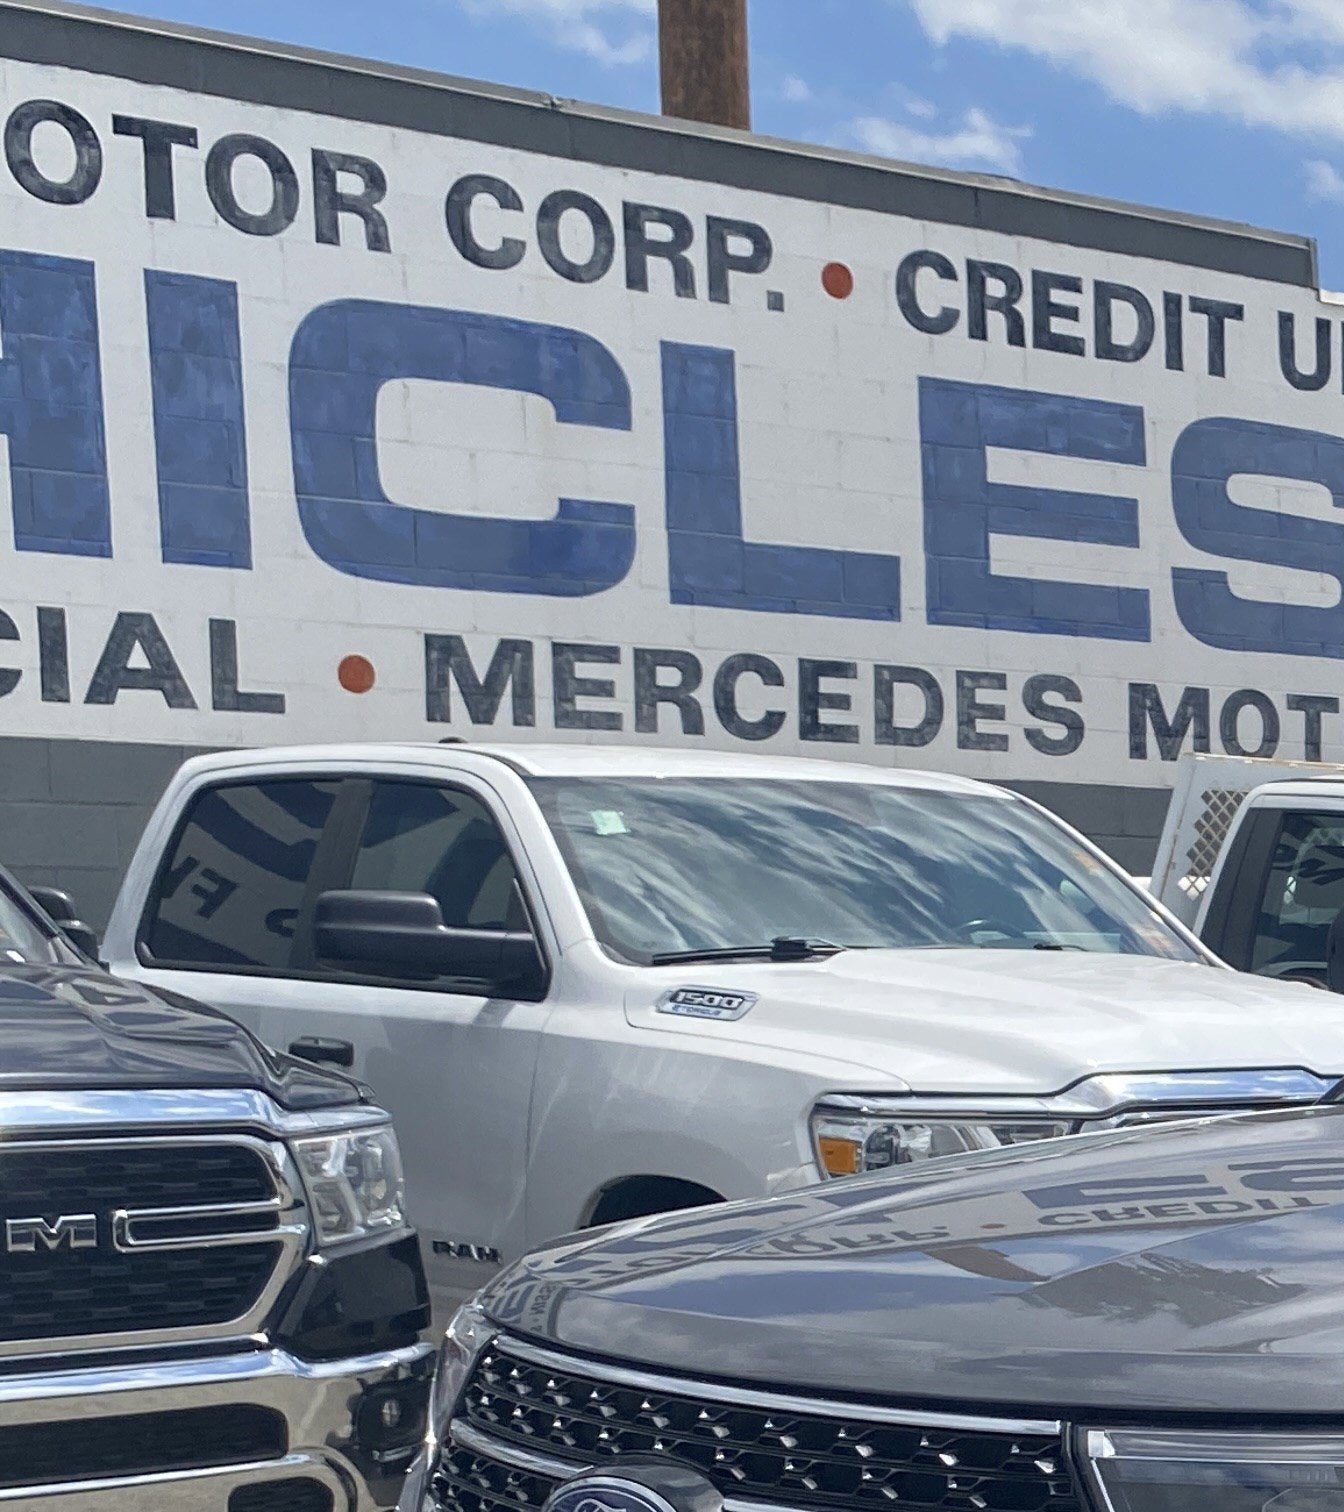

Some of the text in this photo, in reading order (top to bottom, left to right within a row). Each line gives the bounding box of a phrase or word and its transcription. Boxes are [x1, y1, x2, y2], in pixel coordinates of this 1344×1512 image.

[445, 173, 785, 313] CORP.
[895, 249, 1244, 378] CREDIT
[0, 605, 287, 715] IAL
[423, 632, 1085, 757] MERCEDES
[675, 992, 743, 1009] 1500
[433, 1239, 503, 1265] RAM
